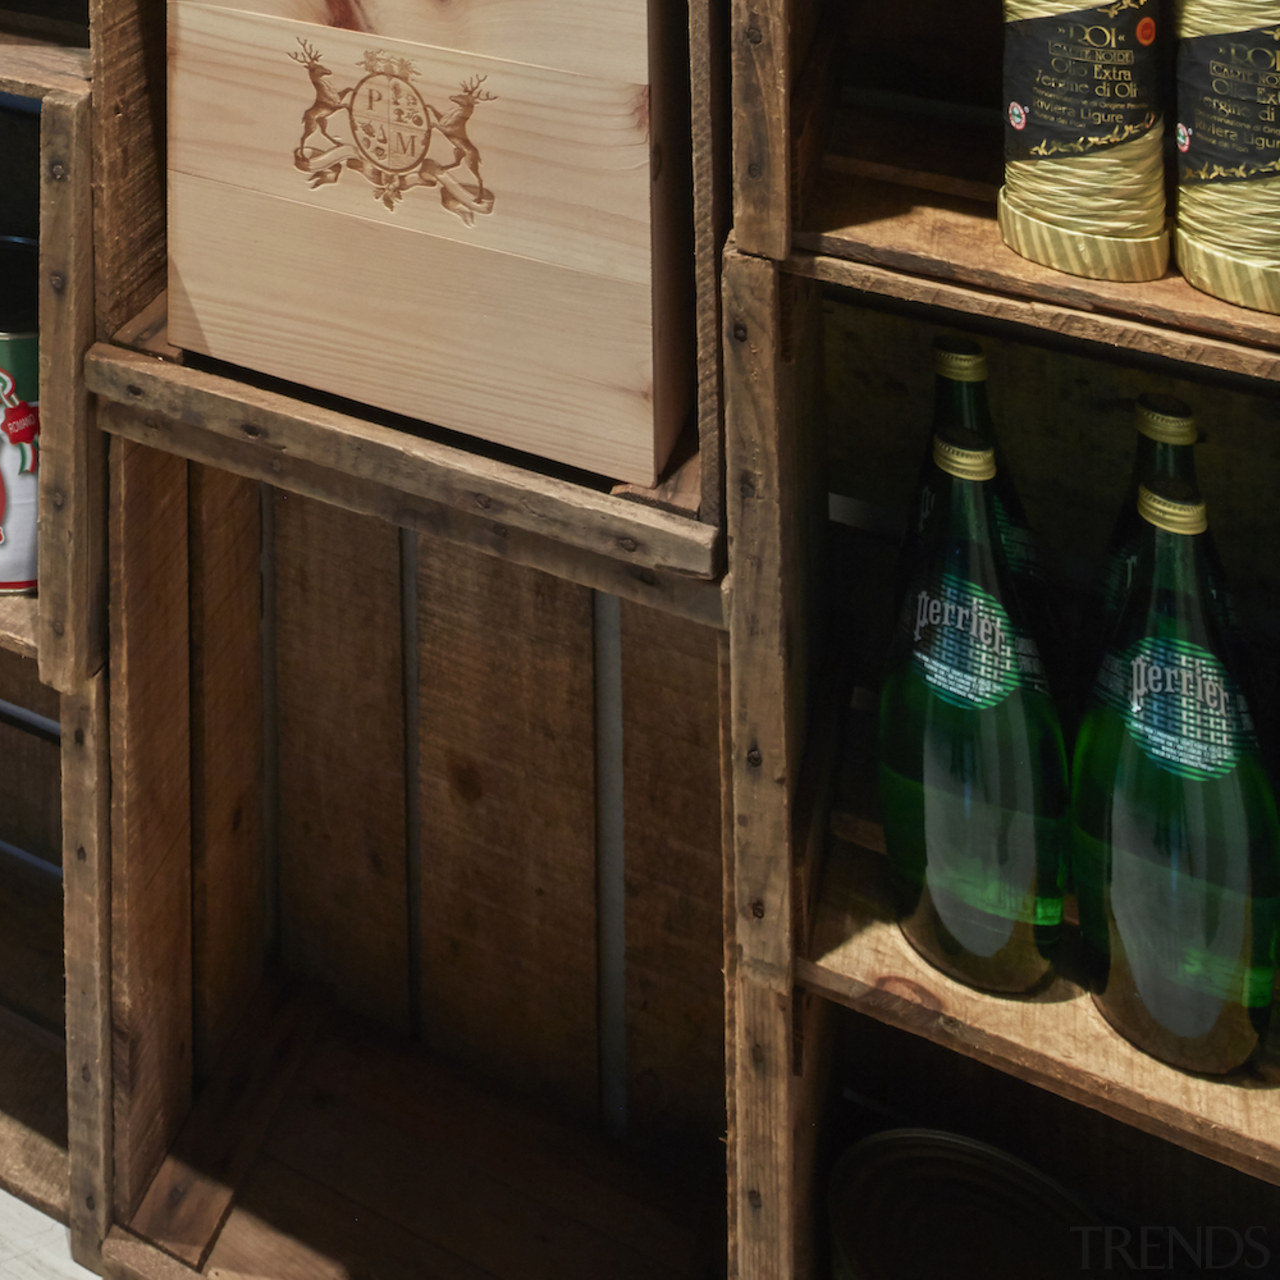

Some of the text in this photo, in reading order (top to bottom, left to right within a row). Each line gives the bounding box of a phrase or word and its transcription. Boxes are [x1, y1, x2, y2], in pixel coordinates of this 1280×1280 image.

[1093, 63, 1132, 81] Extra
[366, 87, 383, 111] P
[1095, 82, 1111, 97] di
[1080, 108, 1125, 125] Ligure
[394, 132, 418, 157] M
[913, 590, 1006, 656] perrier
[1130, 655, 1230, 718] perrier
